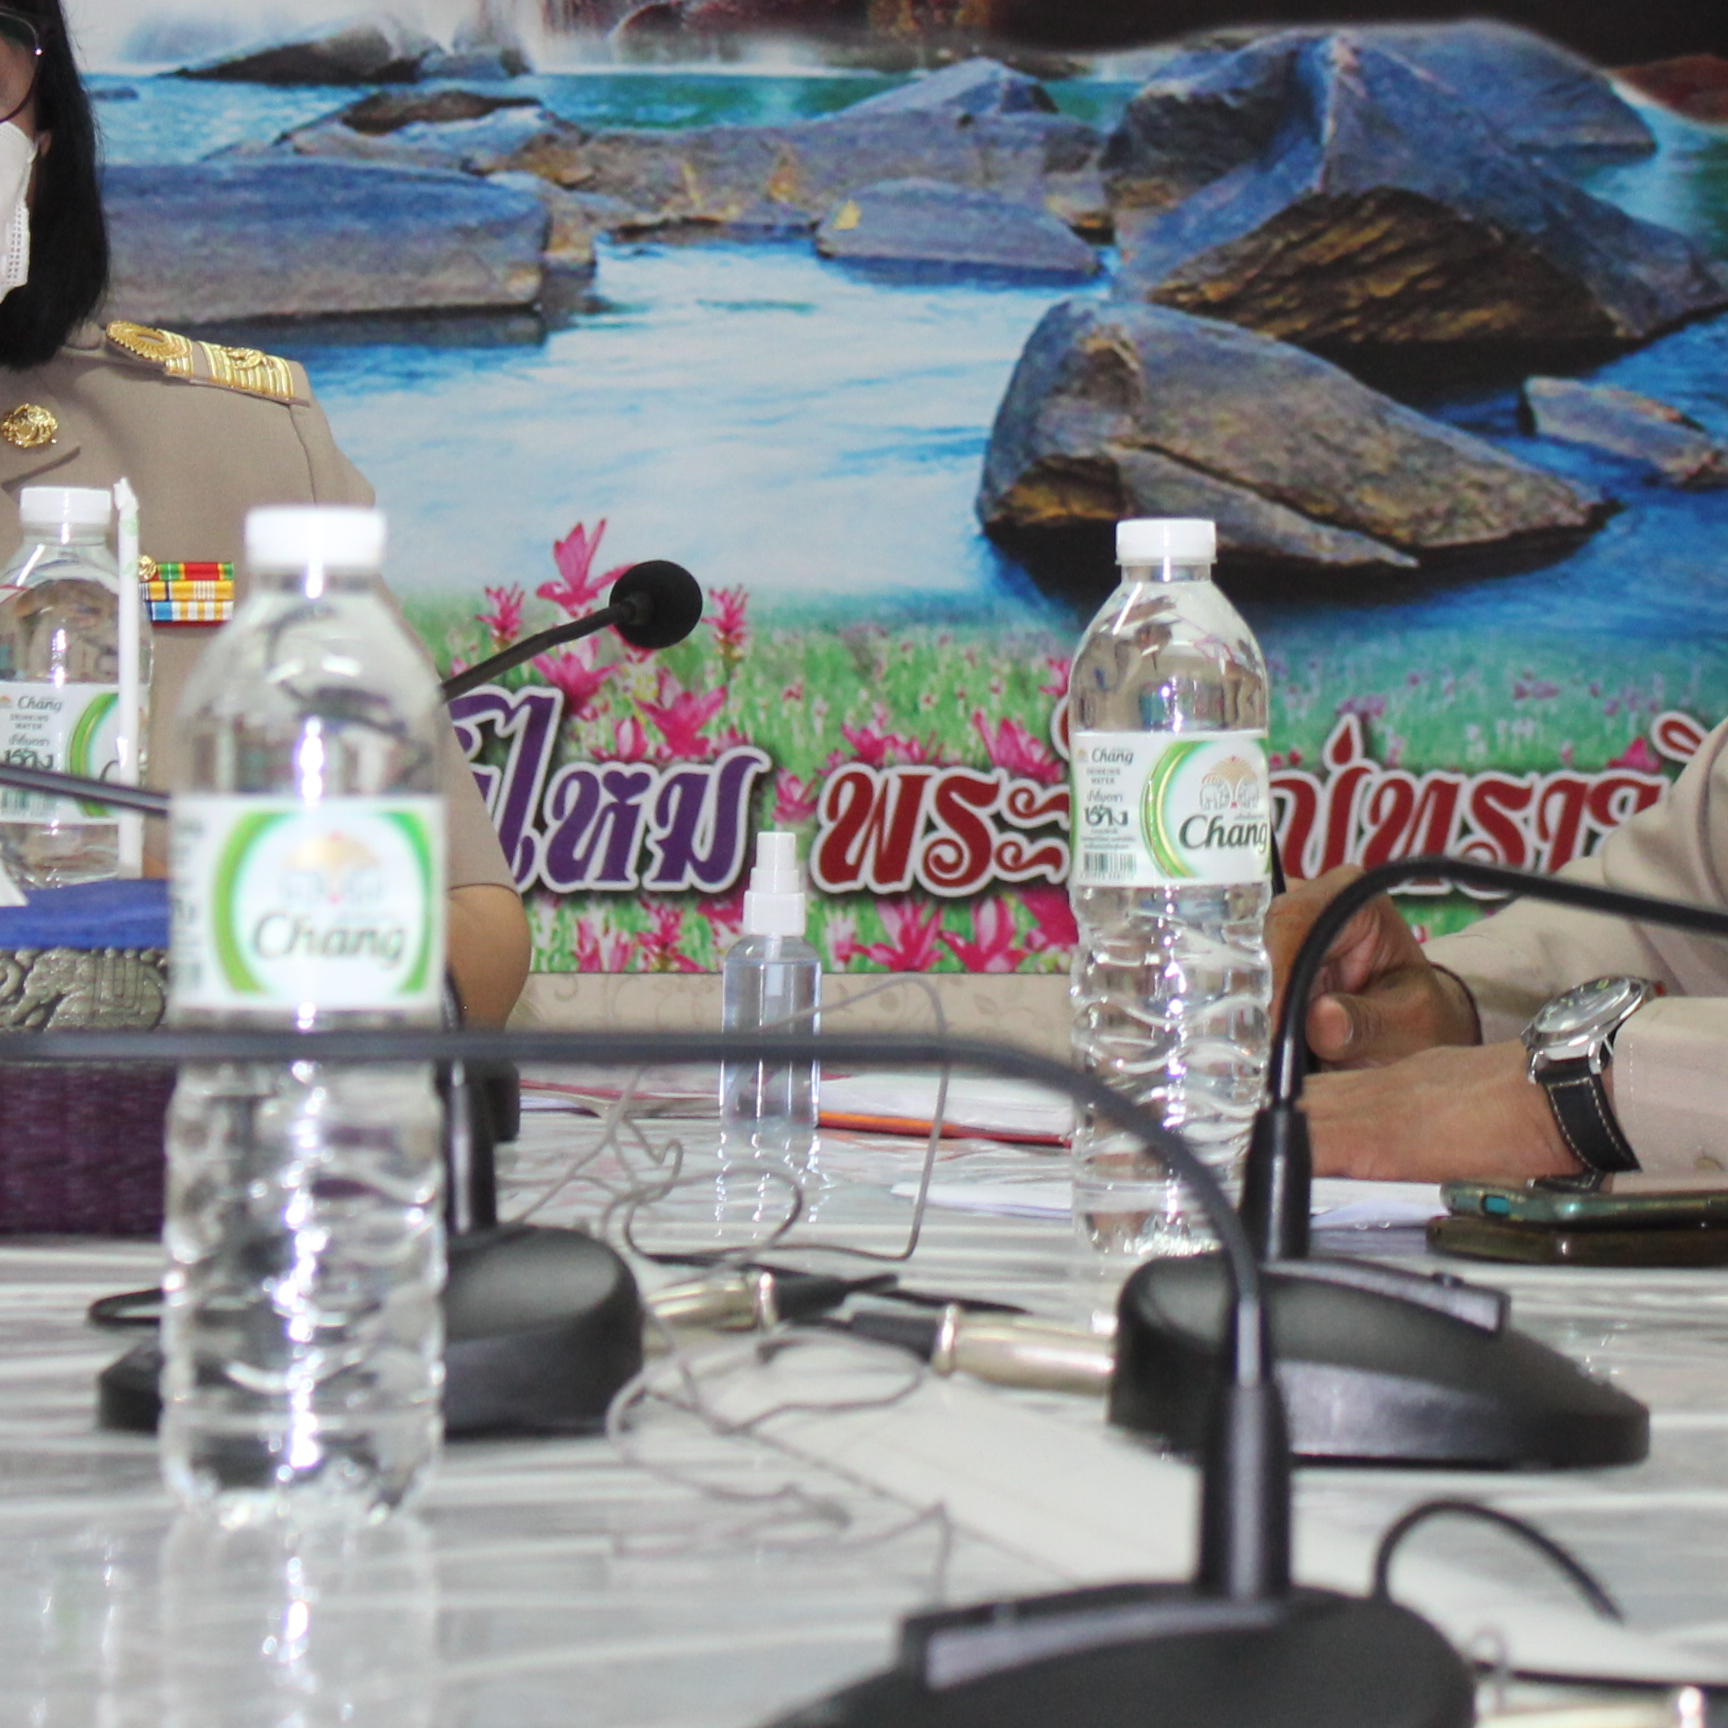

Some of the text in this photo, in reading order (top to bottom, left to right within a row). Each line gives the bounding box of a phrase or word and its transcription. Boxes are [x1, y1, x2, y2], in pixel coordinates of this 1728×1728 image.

[17, 695, 64, 712] Chang
[1091, 747, 1134, 765] Chang
[448, 684, 771, 895] ไหม
[1178, 813, 1268, 854] Chang
[251, 911, 406, 972] Chang
